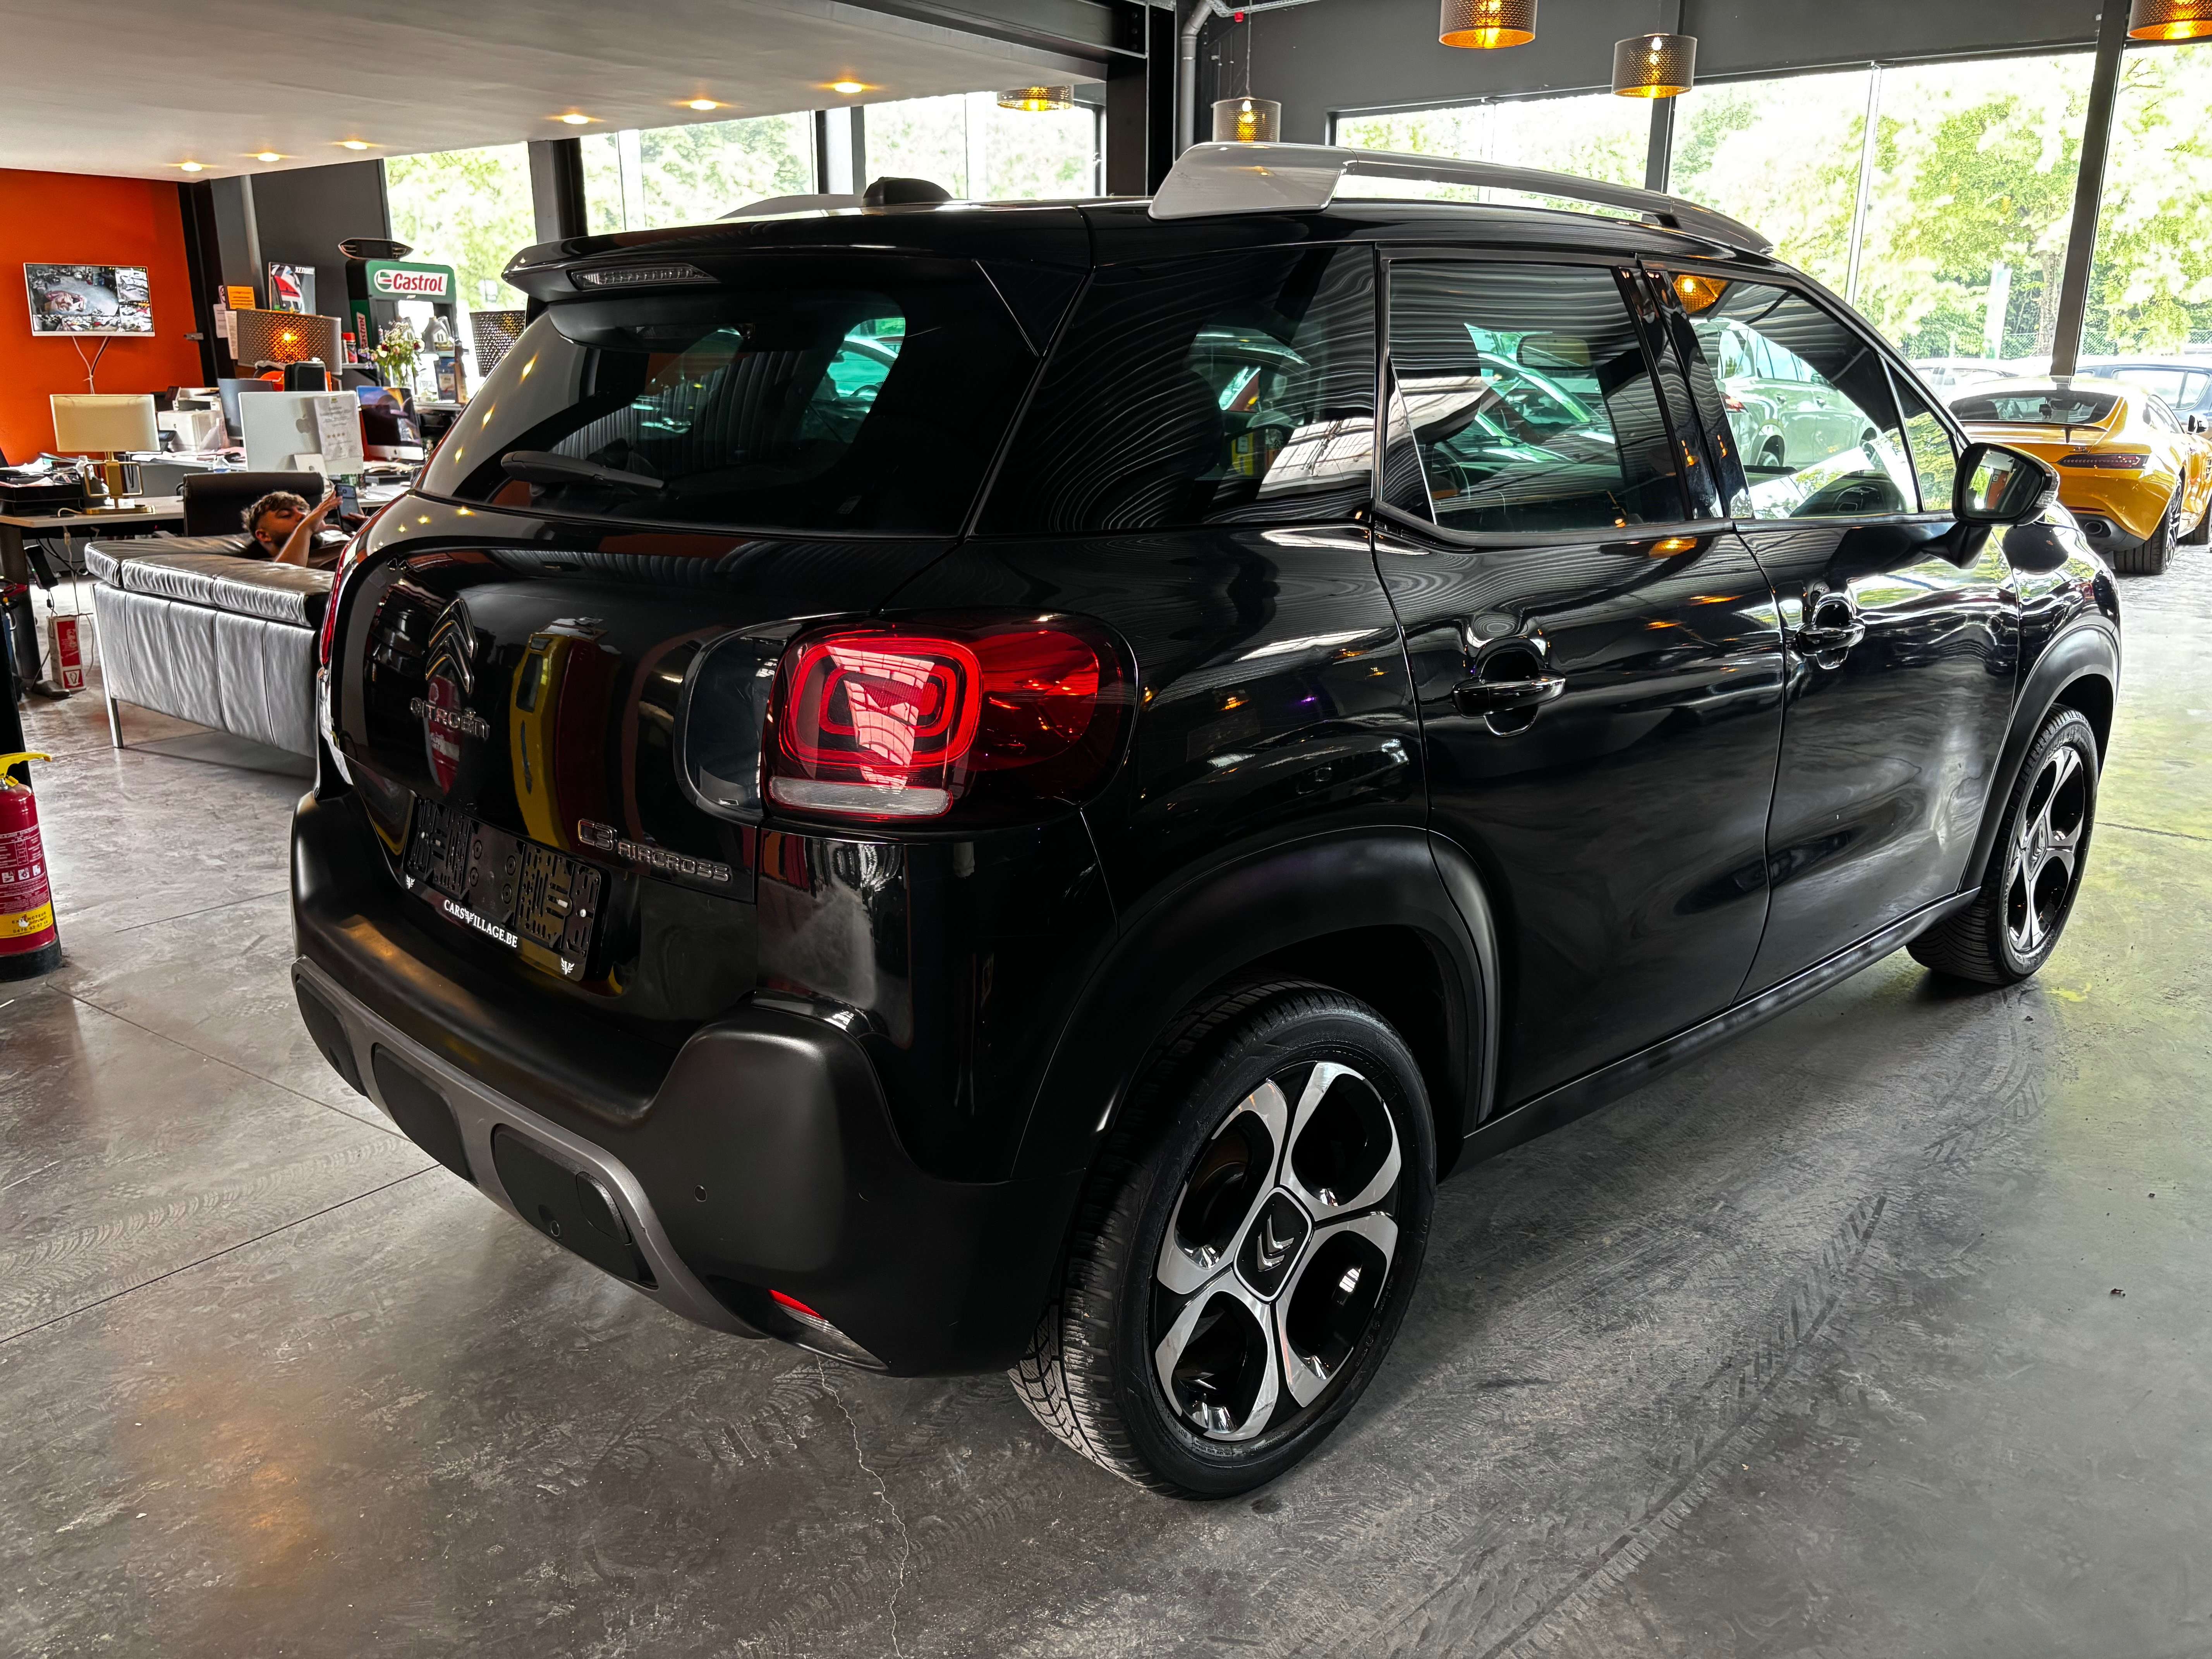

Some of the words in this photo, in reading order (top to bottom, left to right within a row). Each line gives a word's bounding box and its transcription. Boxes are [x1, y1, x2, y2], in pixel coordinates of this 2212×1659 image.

[393, 273, 443, 292] Castrol
[578, 818, 617, 850] C3
[618, 839, 732, 882] AIRCROSS
